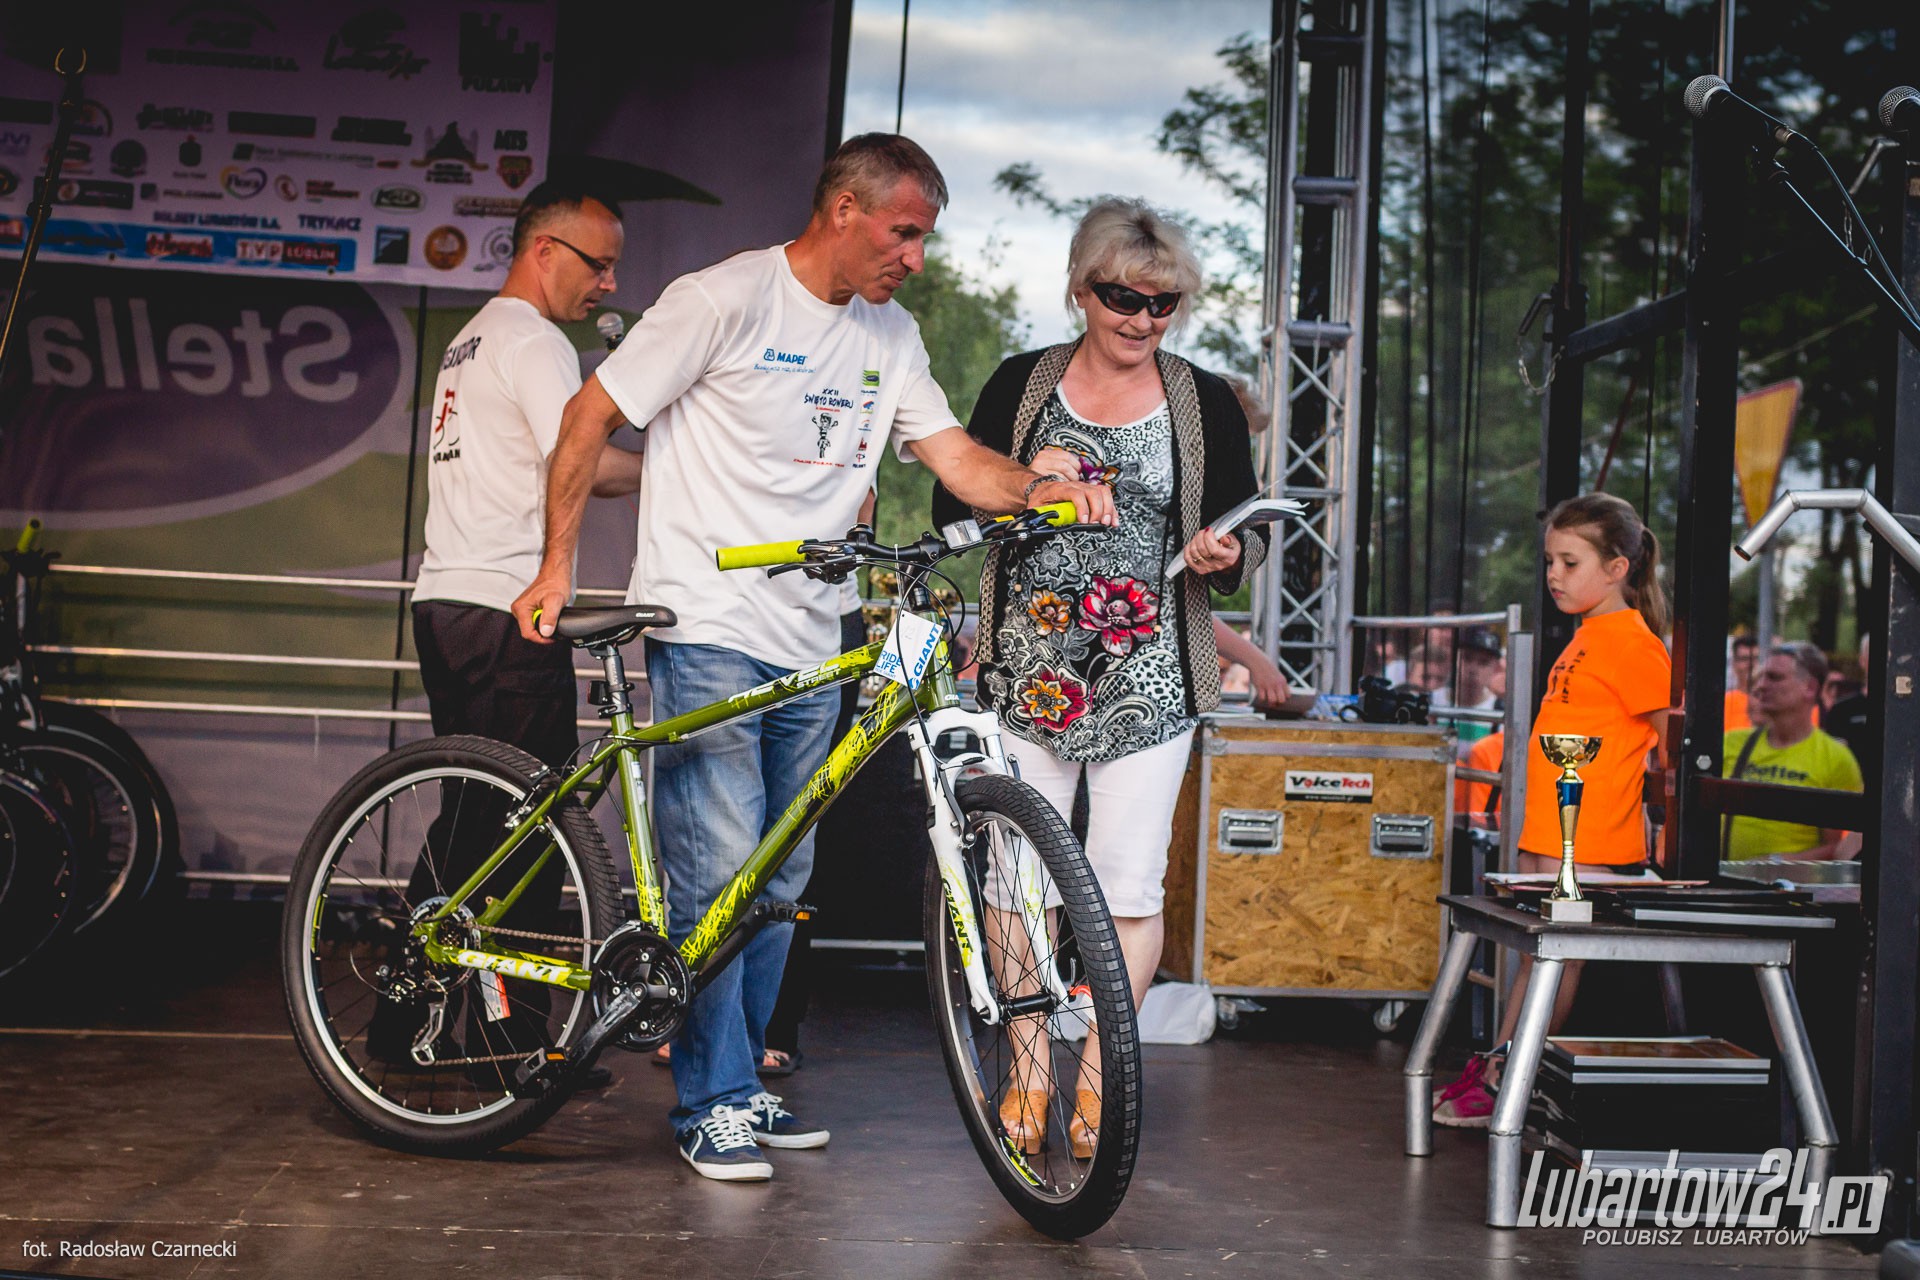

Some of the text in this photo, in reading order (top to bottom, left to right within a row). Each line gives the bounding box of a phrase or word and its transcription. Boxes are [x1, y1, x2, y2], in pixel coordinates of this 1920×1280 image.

[240, 241, 336, 260] TVP LUBLIN
[776, 351, 807, 365] MAPEI
[822, 388, 839, 397] XXII
[880, 650, 902, 667] RIDE
[913, 623, 940, 677] GIANT
[876, 660, 897, 674] LIFE
[796, 668, 841, 690] STREET
[942, 878, 974, 953] GIANT
[457, 950, 571, 983] GIANT
